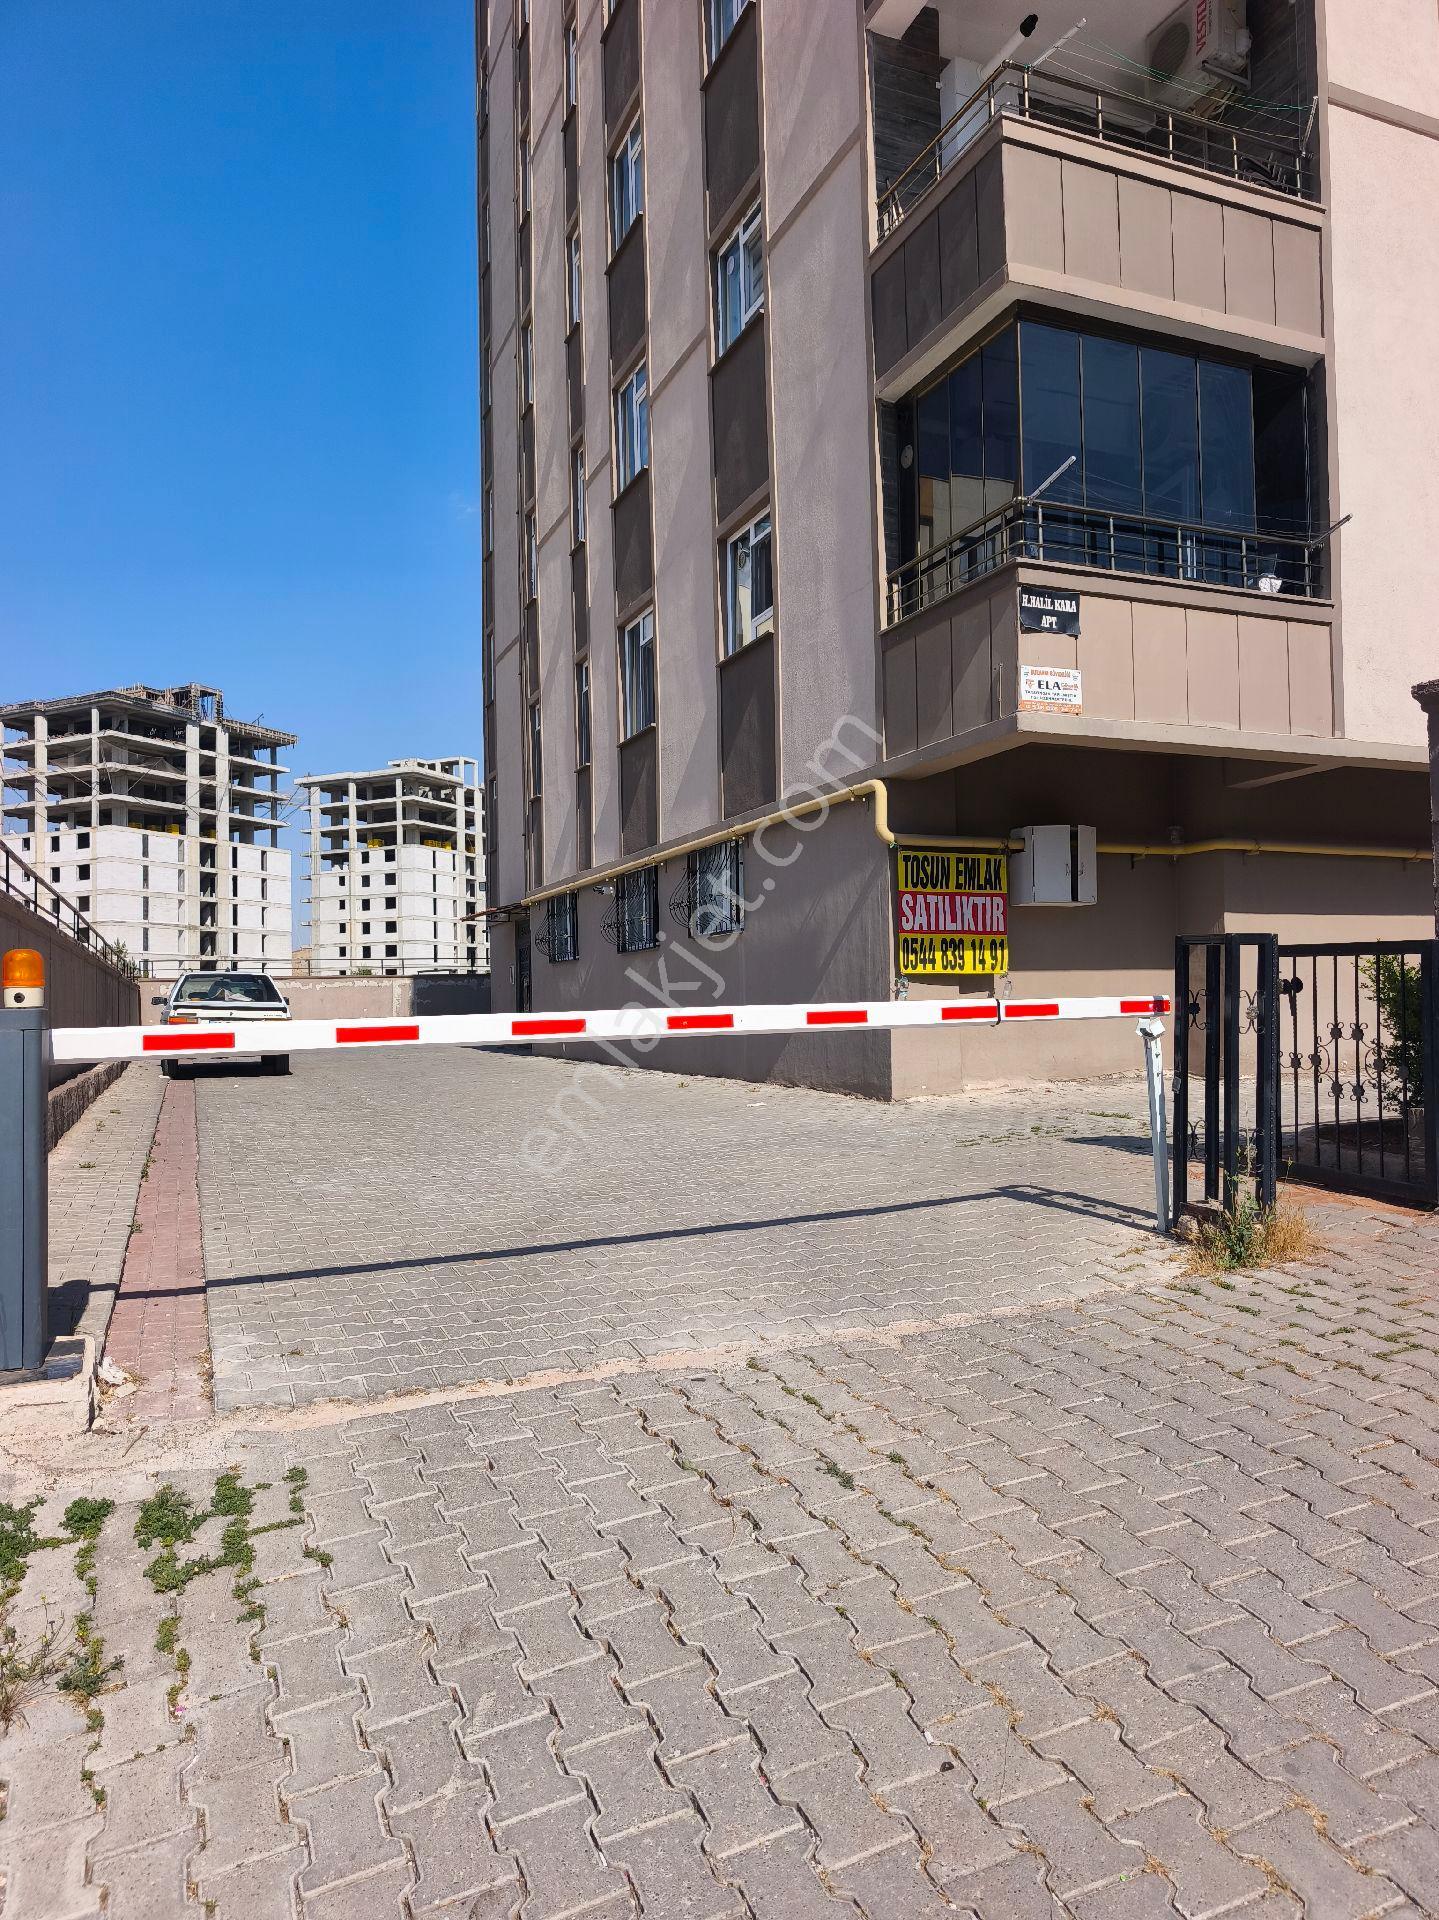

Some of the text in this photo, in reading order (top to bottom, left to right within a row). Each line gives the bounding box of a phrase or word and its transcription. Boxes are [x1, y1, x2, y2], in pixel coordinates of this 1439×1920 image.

[1054, 599, 1077, 613] KARA
[1041, 615, 1057, 629] APT
[1037, 679, 1062, 691] ELA
[902, 854, 1003, 891] TOSUN EMLAK
[901, 893, 1005, 932] SATILIKTIR
[902, 936, 1005, 971] 0544 839 14 91
